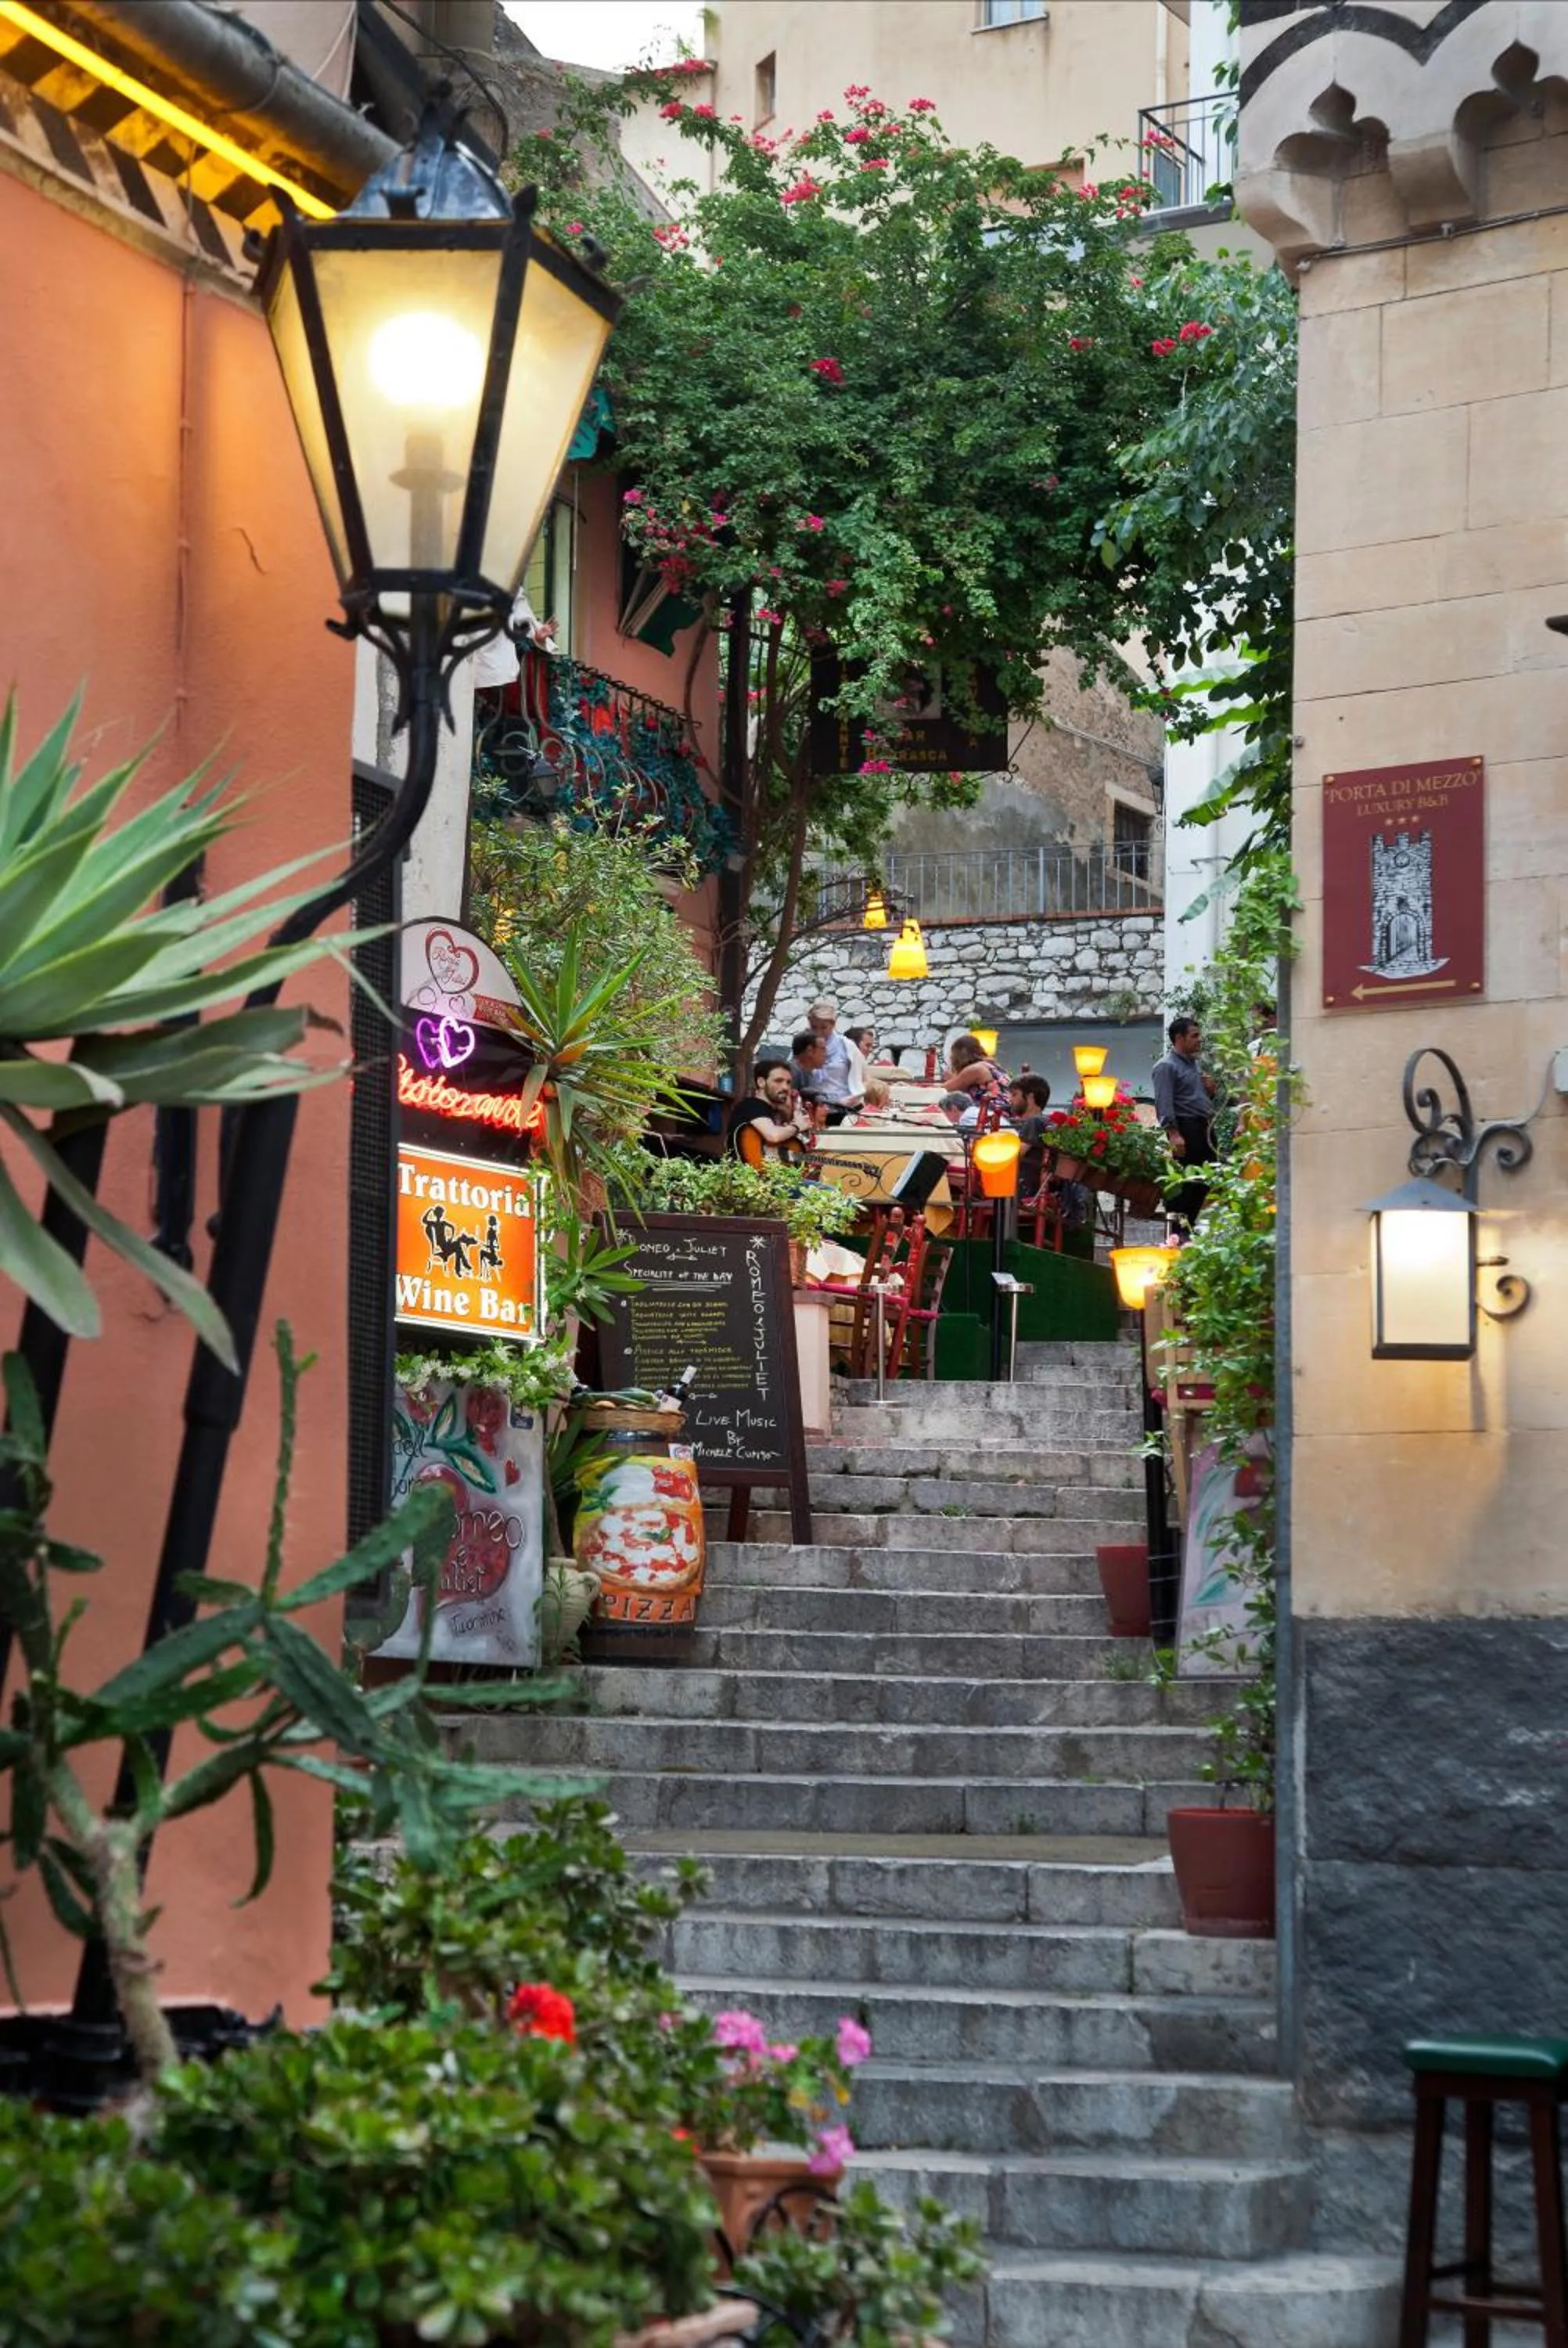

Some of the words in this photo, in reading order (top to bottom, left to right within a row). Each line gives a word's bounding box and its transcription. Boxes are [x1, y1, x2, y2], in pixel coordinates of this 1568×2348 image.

[1391, 780, 1412, 795] DI
[1356, 797, 1415, 817] LUXURY
[397, 1161, 530, 1219] Trattoria
[682, 1237, 728, 1258] JULIET
[395, 1273, 470, 1316] Wine
[480, 1287, 533, 1326] Bar
[695, 1409, 732, 1426] LIVE
[735, 1408, 777, 1428] MUSIC
[602, 1594, 693, 1621] PIZZA
